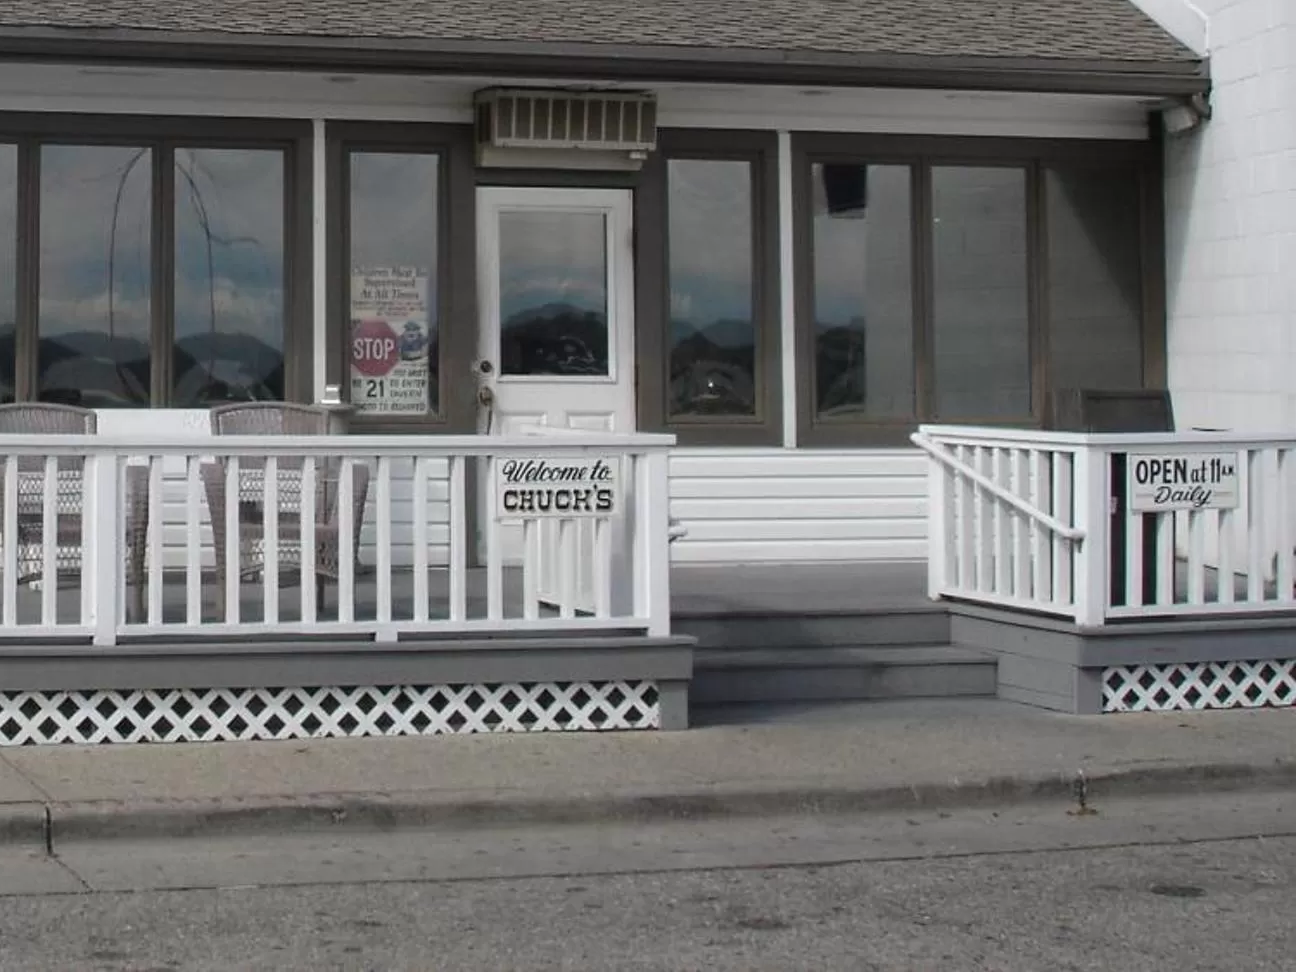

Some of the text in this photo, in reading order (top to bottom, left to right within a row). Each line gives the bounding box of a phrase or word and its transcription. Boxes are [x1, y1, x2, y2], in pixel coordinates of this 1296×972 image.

[354, 337, 395, 361] STOP
[366, 379, 385, 398] 21
[502, 459, 616, 482] Welcome to
[1135, 458, 1188, 485] OPEN
[1190, 460, 1207, 484] at
[503, 484, 614, 512] CHUCK'S
[1153, 485, 1212, 508] Daily
